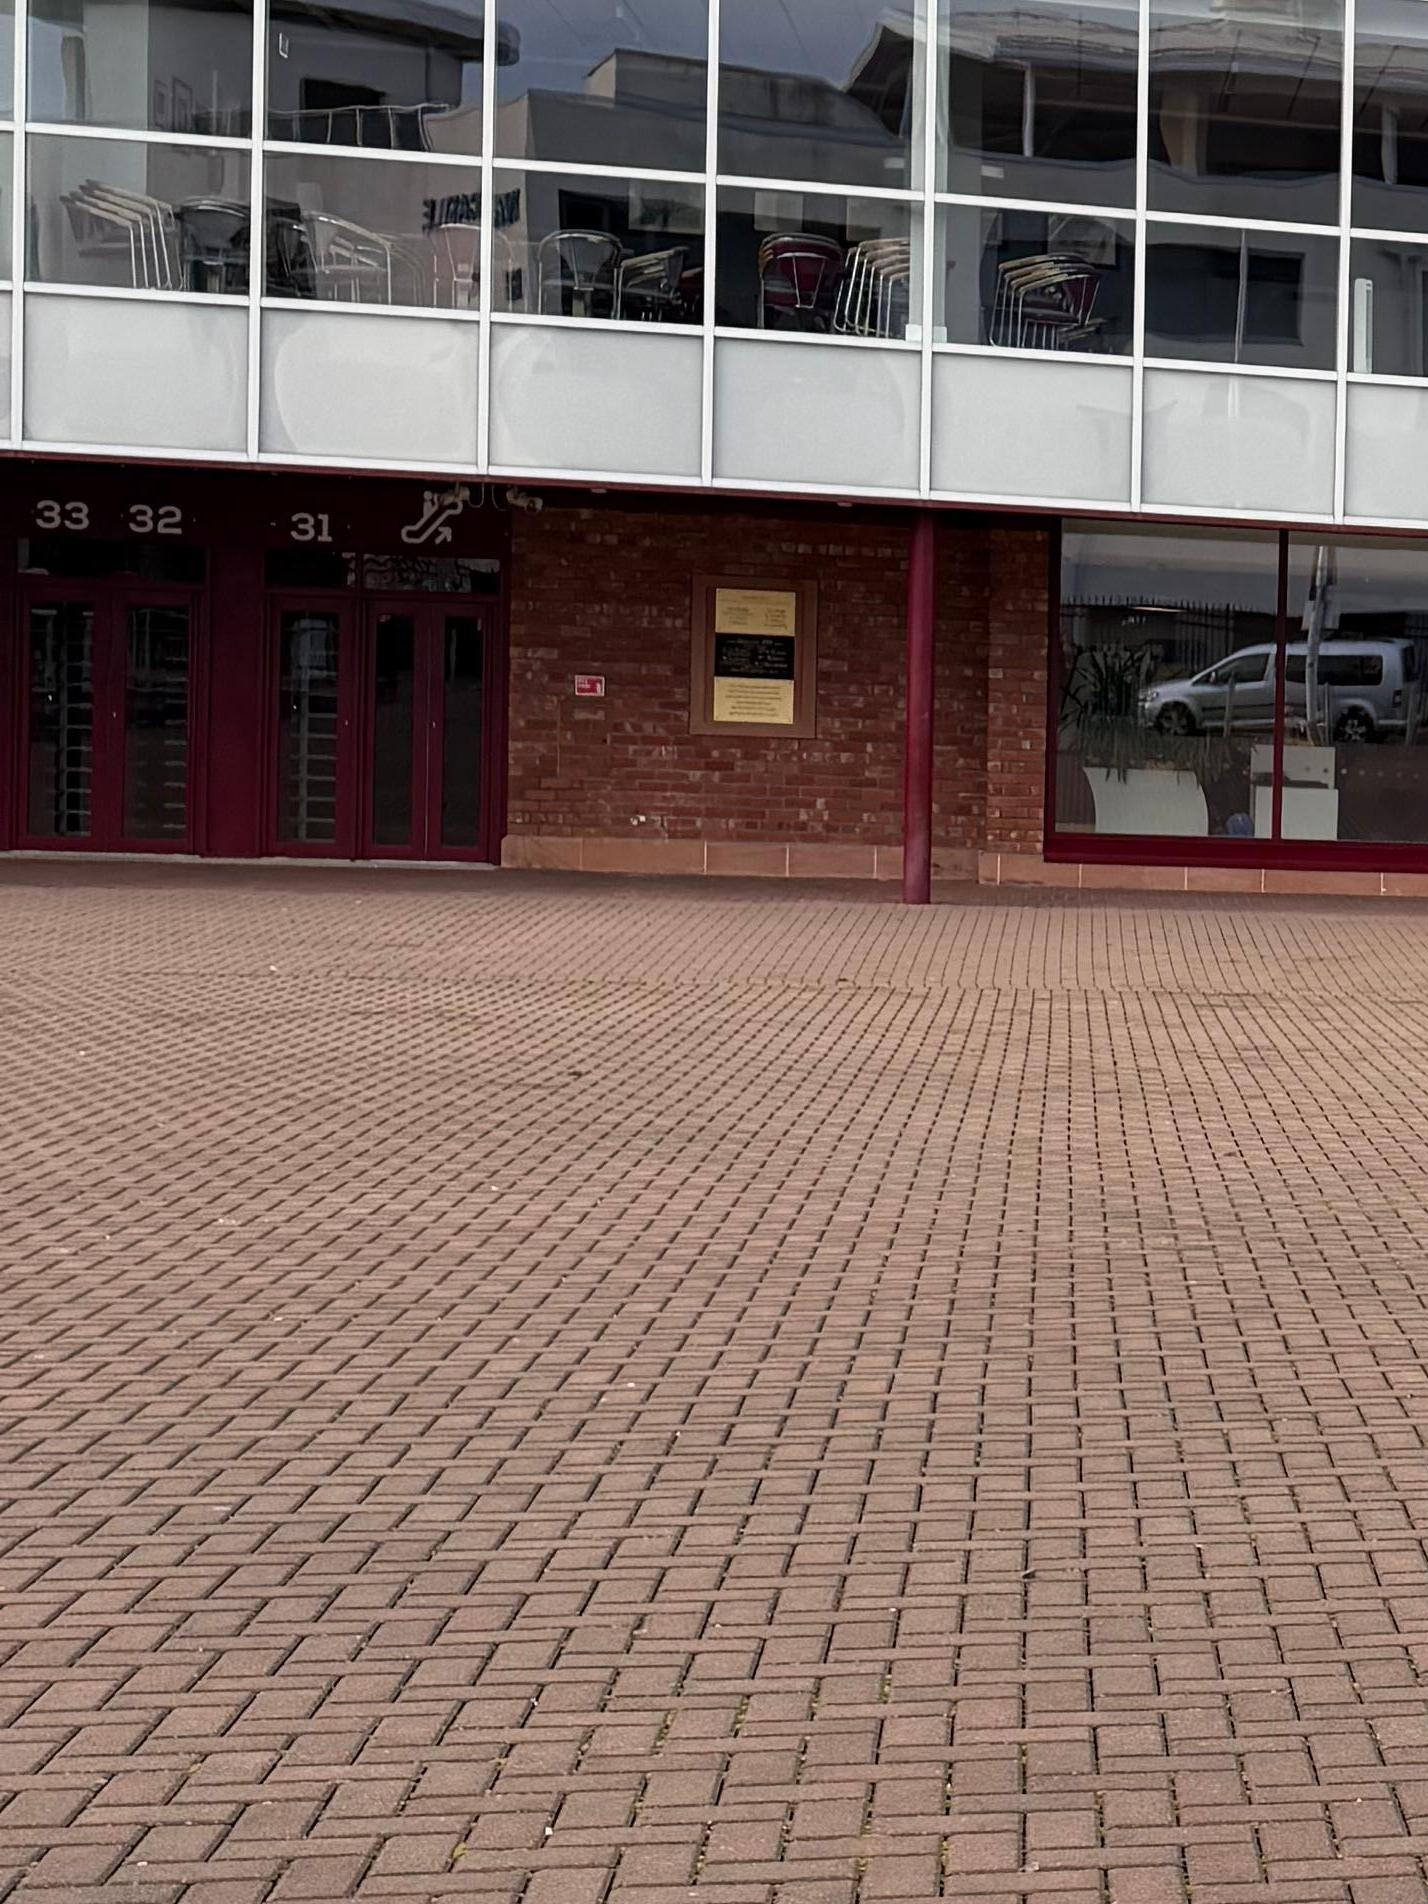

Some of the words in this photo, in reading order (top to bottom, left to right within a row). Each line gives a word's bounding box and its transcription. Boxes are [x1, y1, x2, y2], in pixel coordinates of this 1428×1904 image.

[35, 499, 90, 530] 33
[128, 504, 183, 535] 32
[290, 512, 333, 542] 31
